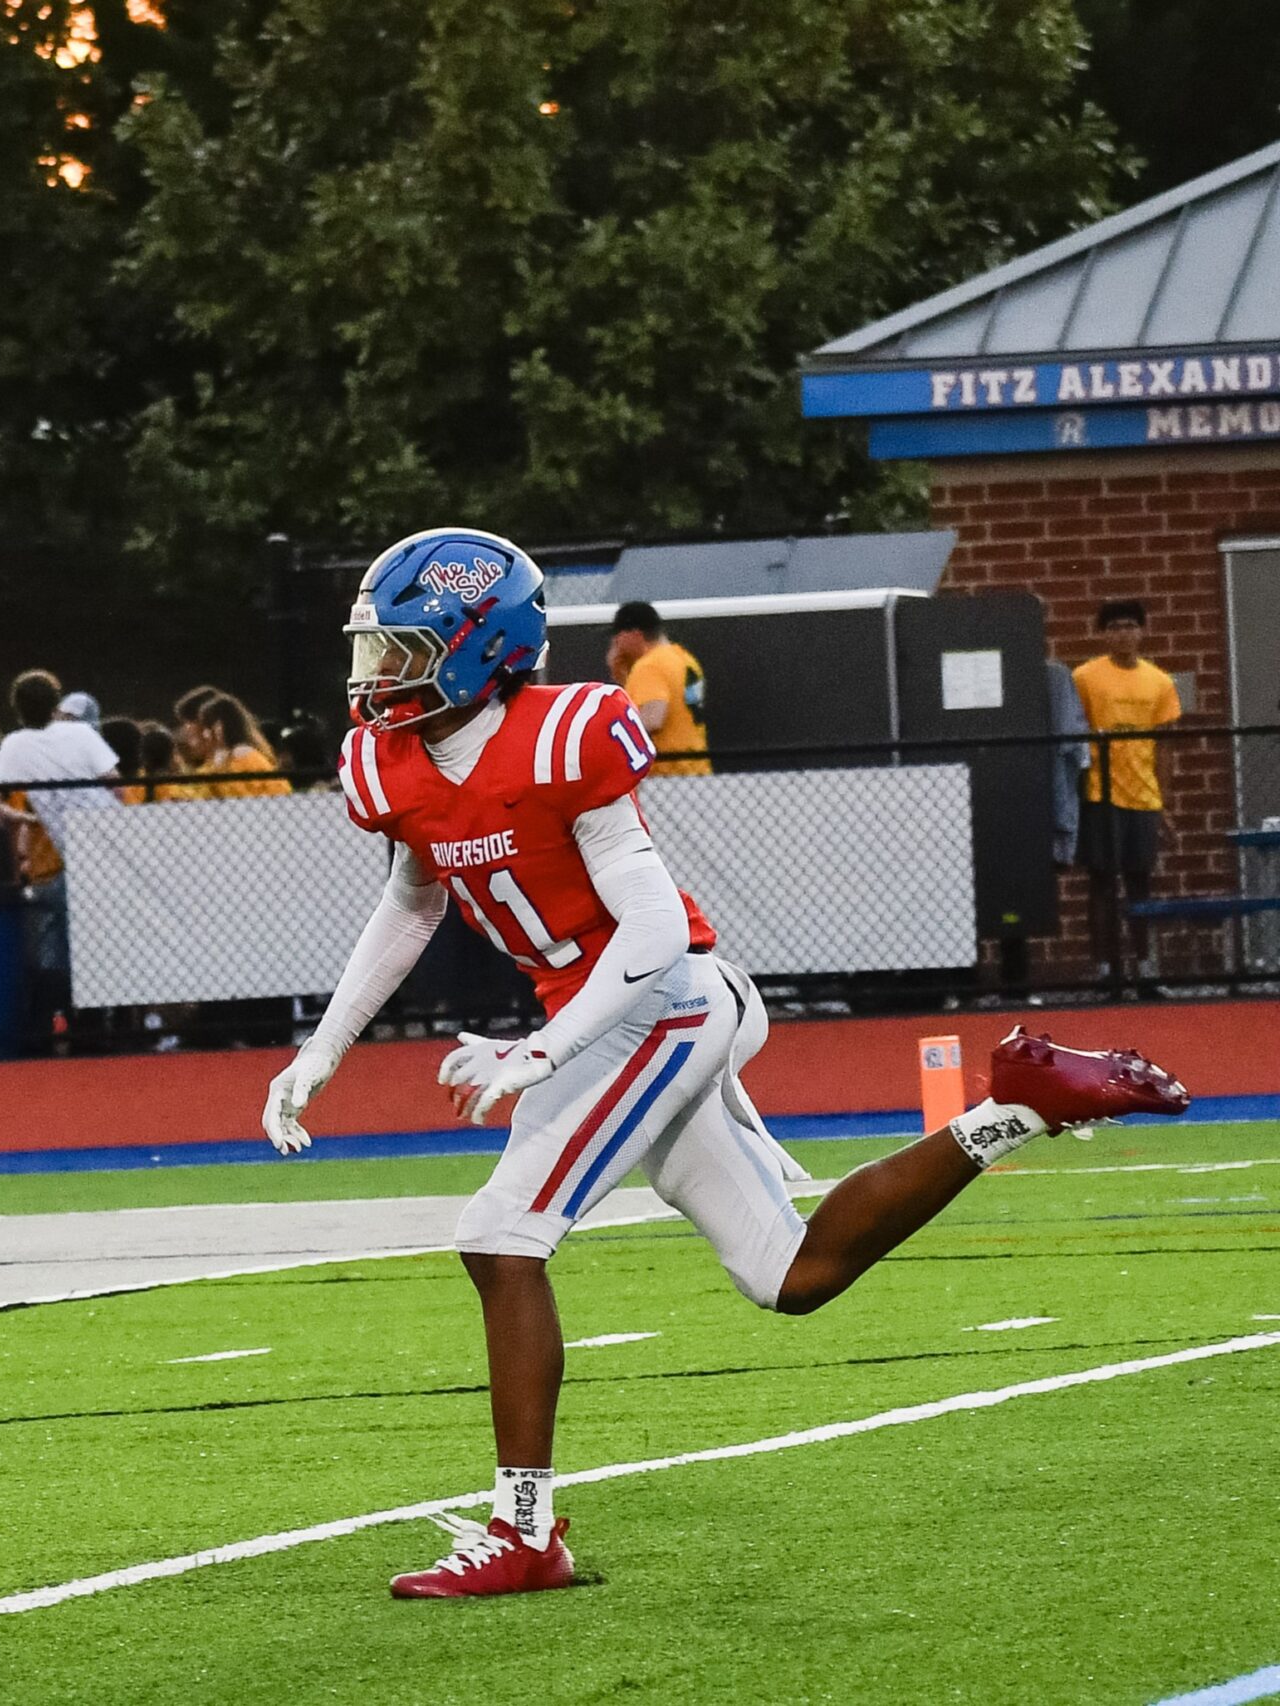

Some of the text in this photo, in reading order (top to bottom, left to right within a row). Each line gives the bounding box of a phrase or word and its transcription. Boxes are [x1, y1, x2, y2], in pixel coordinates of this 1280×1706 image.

[931, 356, 1280, 408] FITZ ALEXAND
[1147, 401, 1280, 440] MEMO
[610, 706, 657, 771] 11
[430, 829, 518, 867] RIVERSIDE
[449, 868, 583, 969] 11
